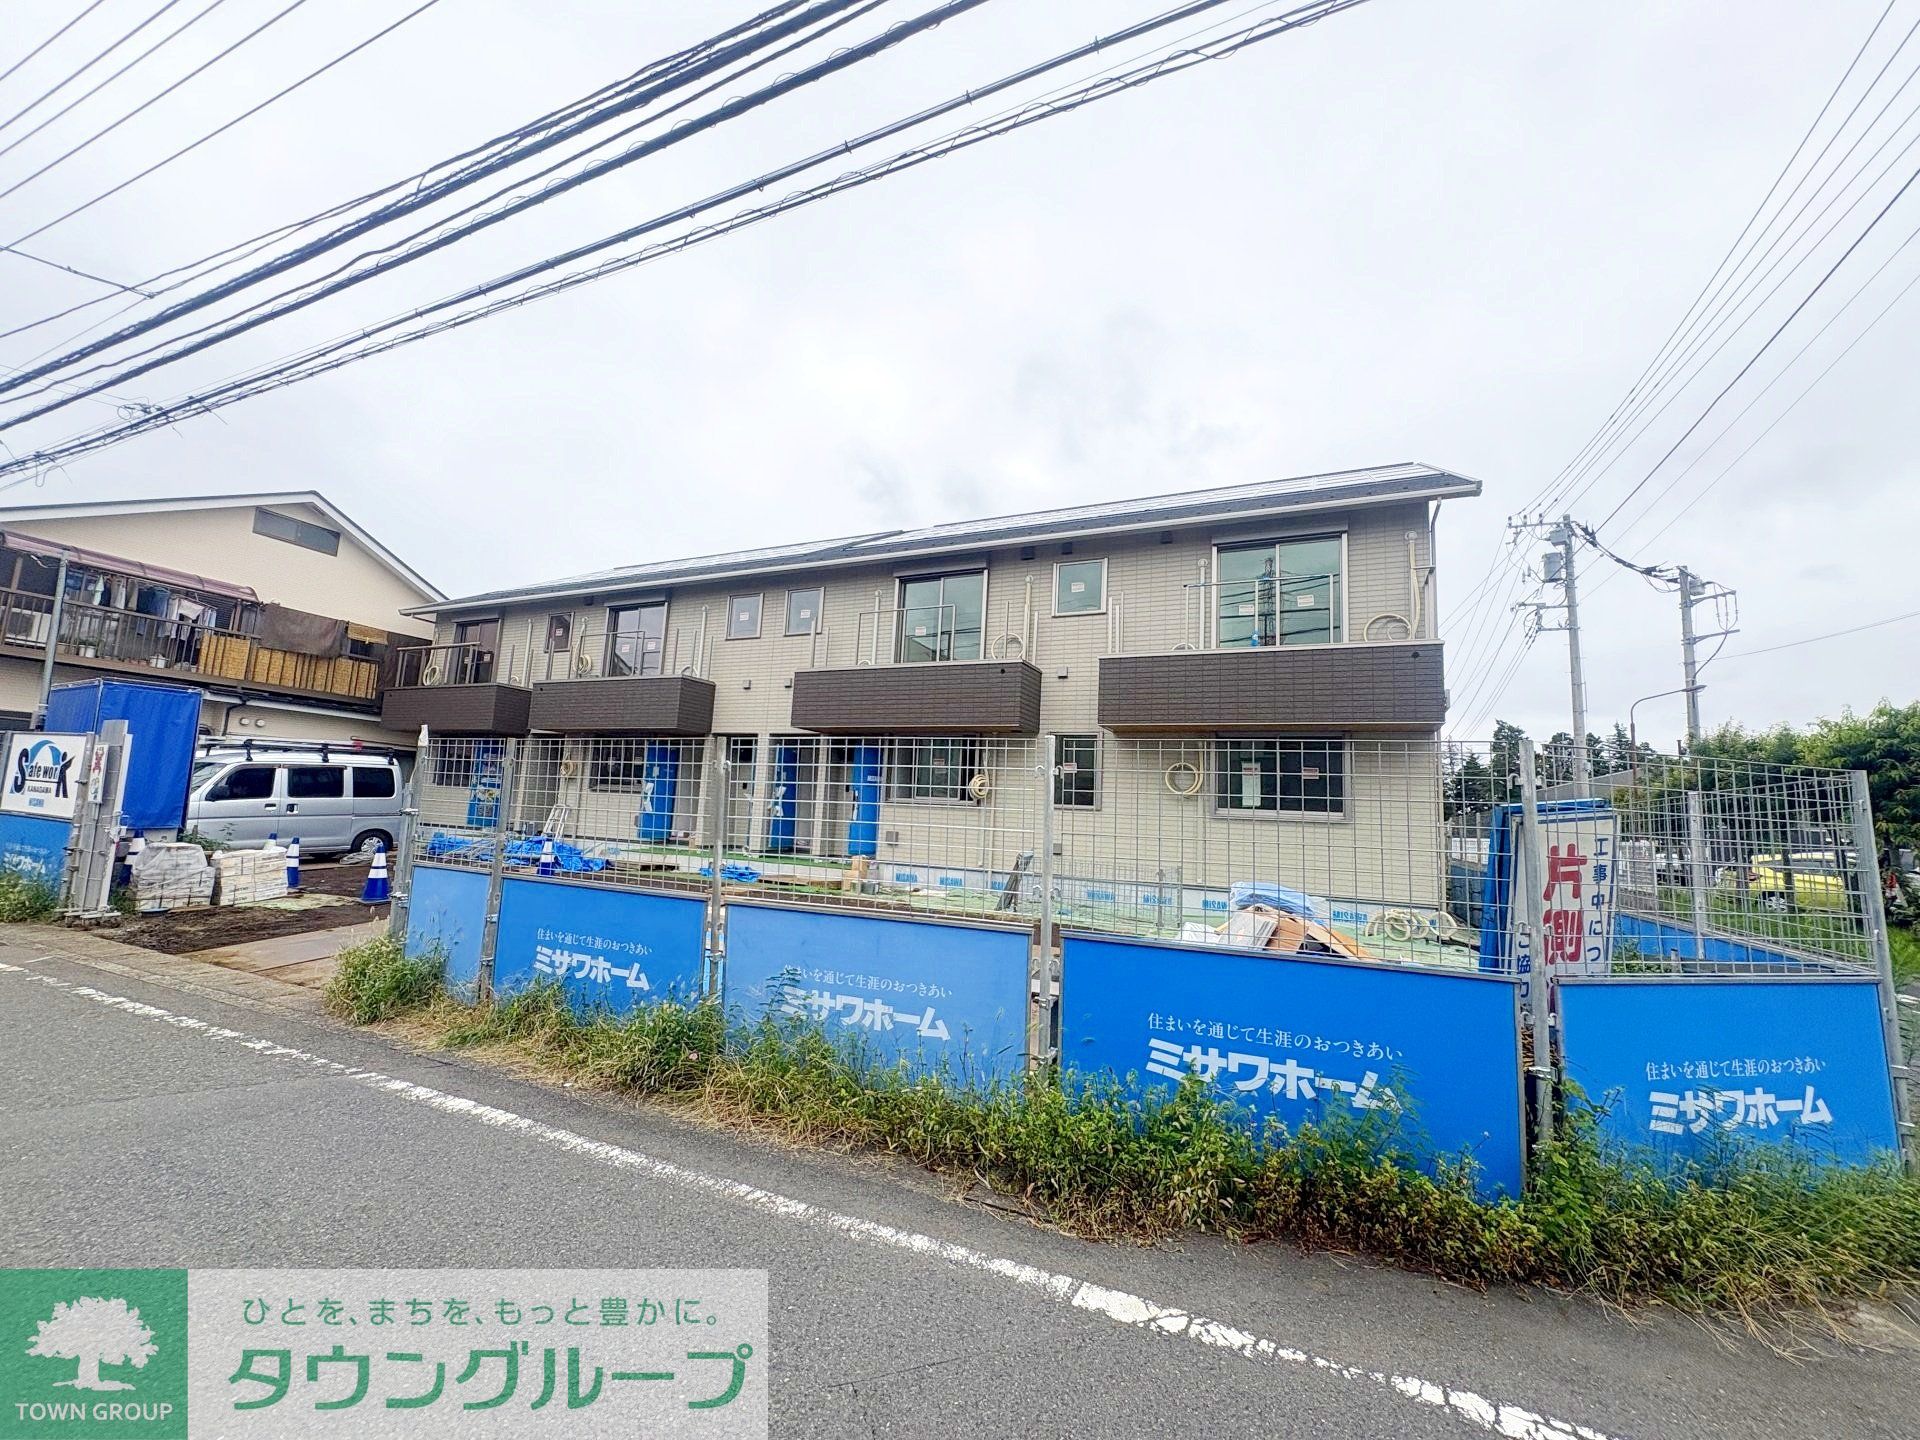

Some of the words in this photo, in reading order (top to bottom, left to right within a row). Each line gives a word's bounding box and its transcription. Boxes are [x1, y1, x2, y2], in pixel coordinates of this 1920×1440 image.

[1542, 843, 1588, 1013] 片側
[1586, 837, 1609, 977] 工事中につ
[537, 927, 653, 956] 住まいを通じて生涯のおつきあい
[533, 945, 650, 991] ミサワホーム
[780, 985, 951, 1041] ミサワホーム
[1148, 1012, 1403, 1061] 住まいを通じて生涯のおつきあい
[1146, 1038, 1403, 1114] ミサワホーム
[1646, 1056, 1826, 1081] 住まいを通じて生涯のおつきあい
[1650, 1085, 1832, 1135] ミサワホーム
